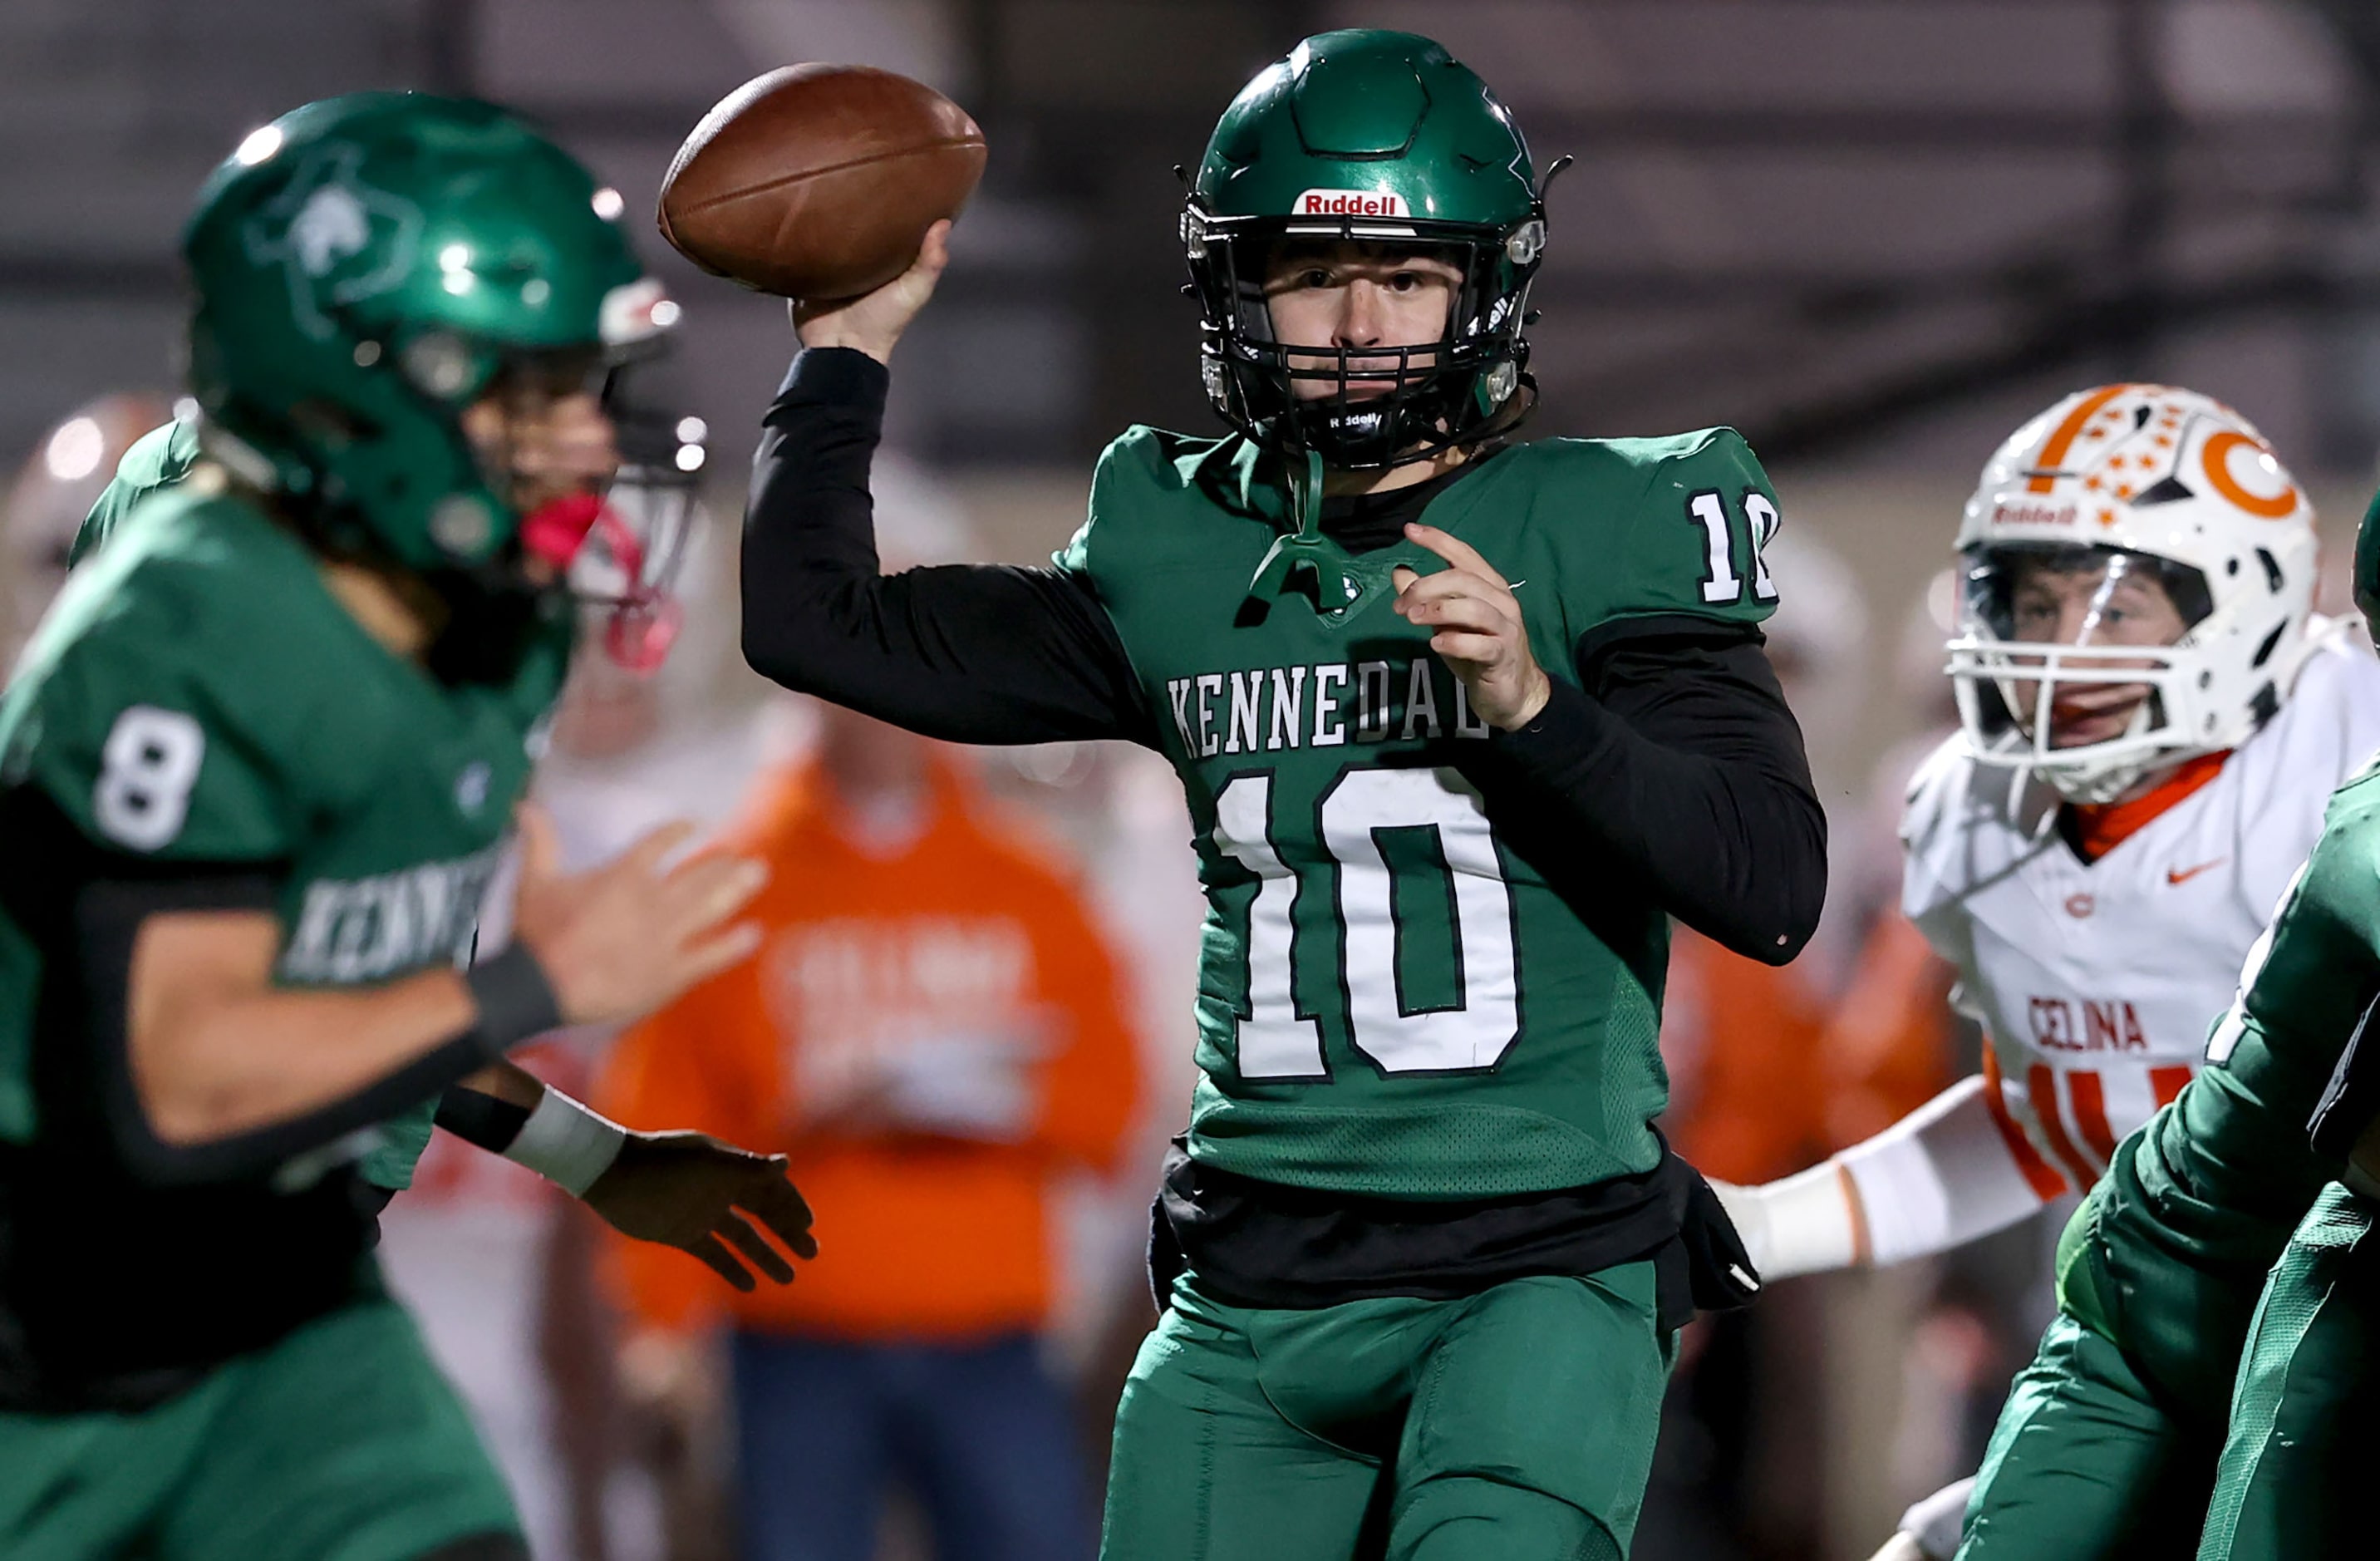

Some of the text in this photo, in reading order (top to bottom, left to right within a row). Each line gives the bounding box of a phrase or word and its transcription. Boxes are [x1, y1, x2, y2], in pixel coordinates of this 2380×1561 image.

[1306, 195, 1395, 215] Riddell
[2201, 431, 2297, 519] C
[93, 703, 206, 854] 8
[1212, 766, 1520, 1081] 10
[2028, 997, 2147, 1051] CELINA
